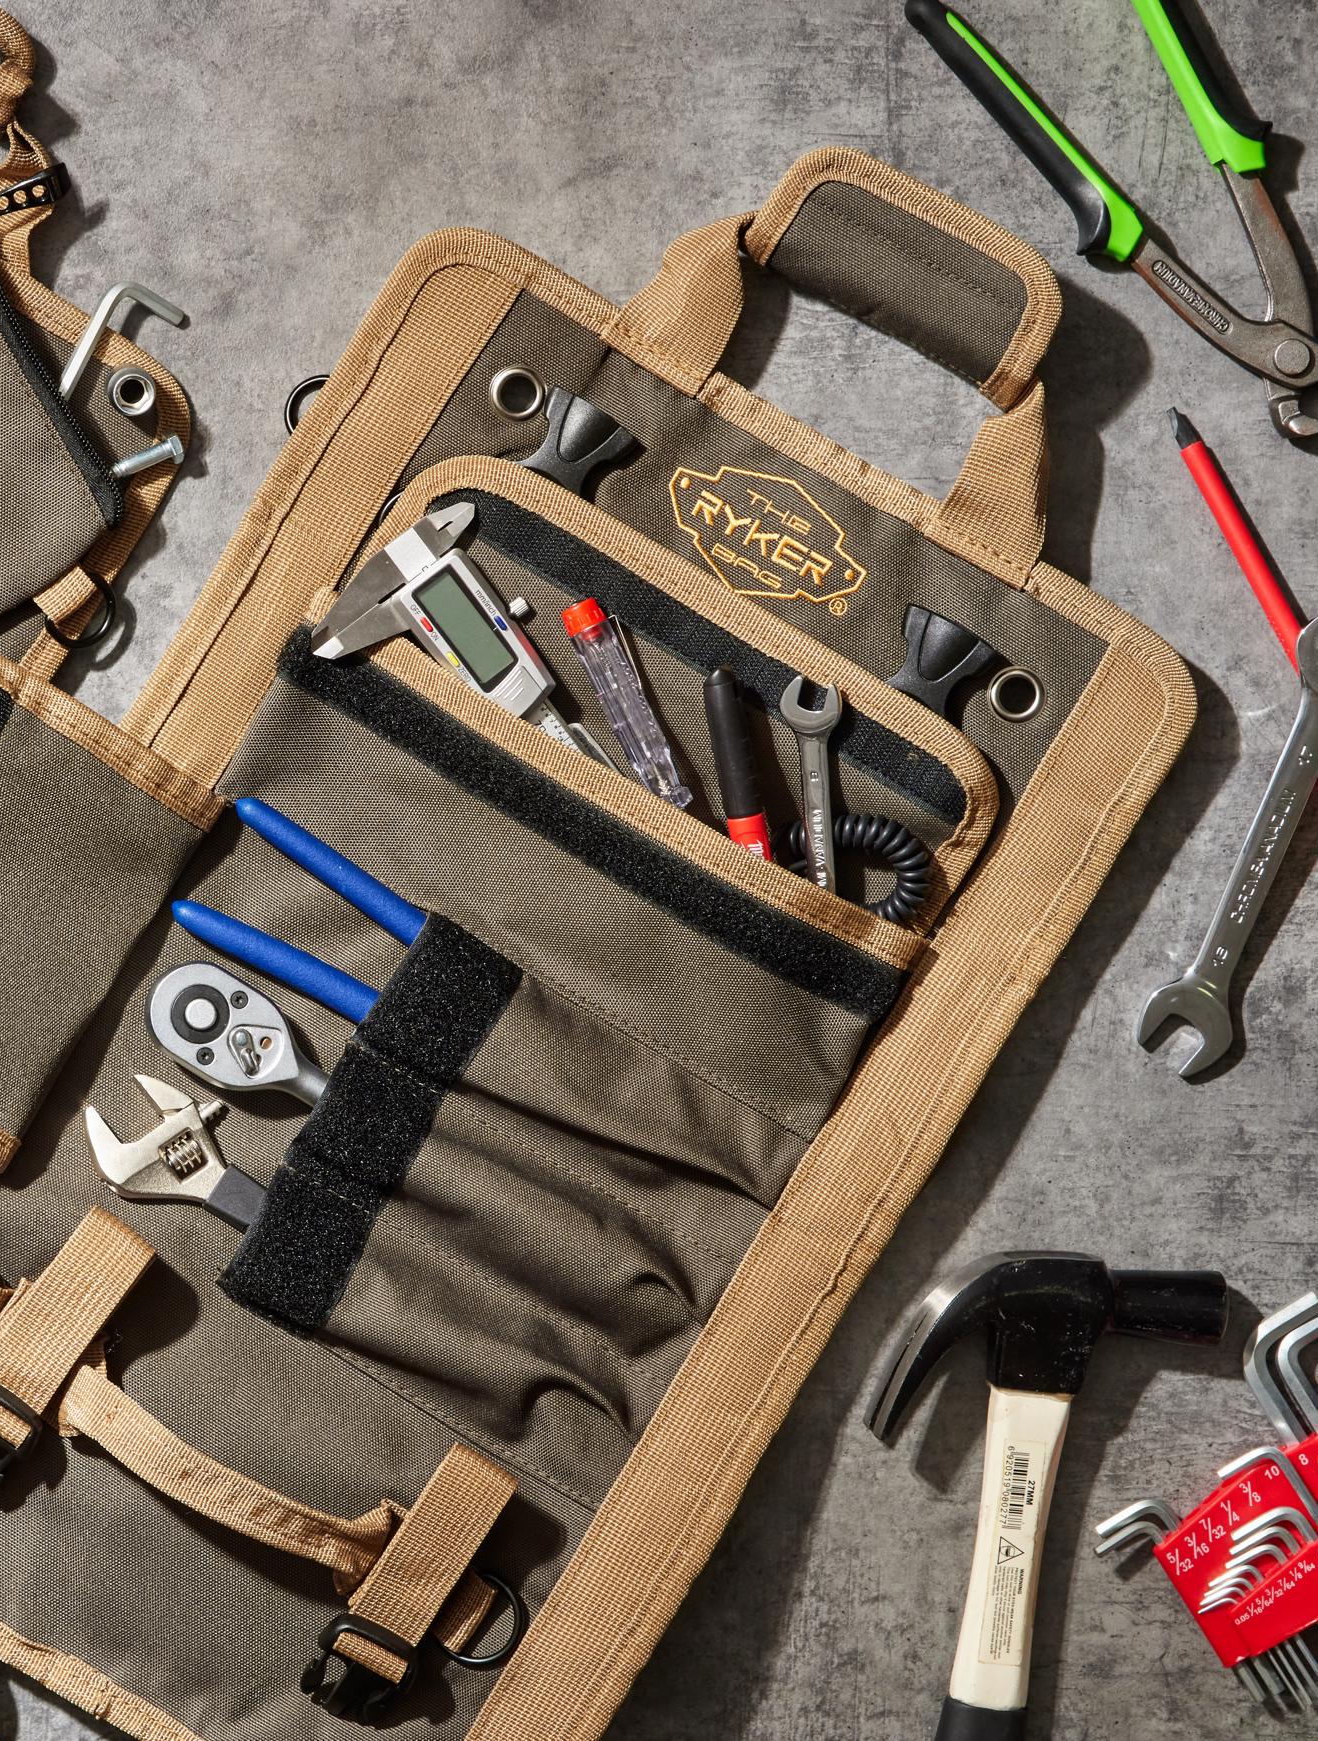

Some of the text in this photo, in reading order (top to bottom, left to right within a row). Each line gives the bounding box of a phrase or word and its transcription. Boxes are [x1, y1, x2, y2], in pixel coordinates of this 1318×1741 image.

[746, 488, 812, 536] THE
[691, 489, 834, 587] RYKER
[712, 542, 783, 589] BAG
[410, 604, 421, 616] OFF
[475, 589, 496, 616] mm/inch
[430, 631, 439, 641] ON
[1264, 1453, 1309, 1480] 10 8
[1026, 1480, 1036, 1506] 27MM
[1166, 1481, 1262, 1576] 5/32 3/16 7/32 1/4 3/8
[1234, 1613, 1250, 1625] 0.05
